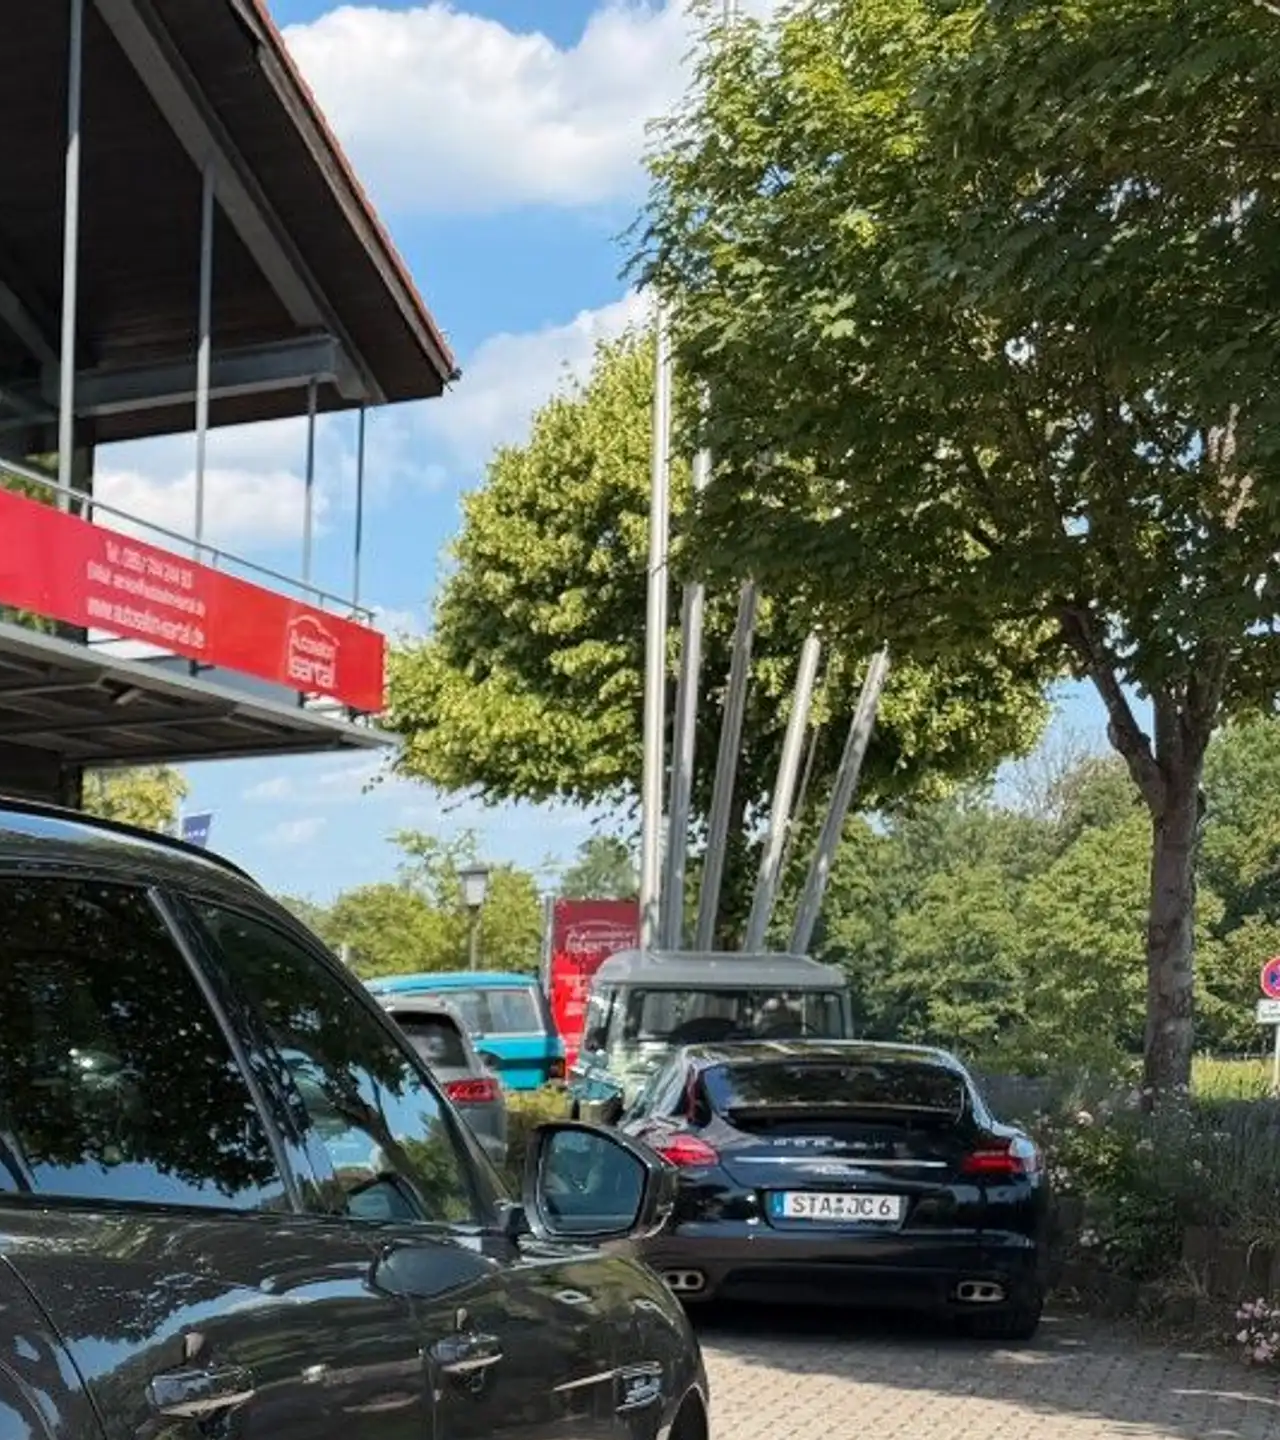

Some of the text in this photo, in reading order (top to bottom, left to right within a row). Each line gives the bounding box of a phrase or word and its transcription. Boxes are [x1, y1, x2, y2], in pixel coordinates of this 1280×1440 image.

[287, 646, 336, 689] Isartal
[792, 1195, 891, 1217] STA JC 6
